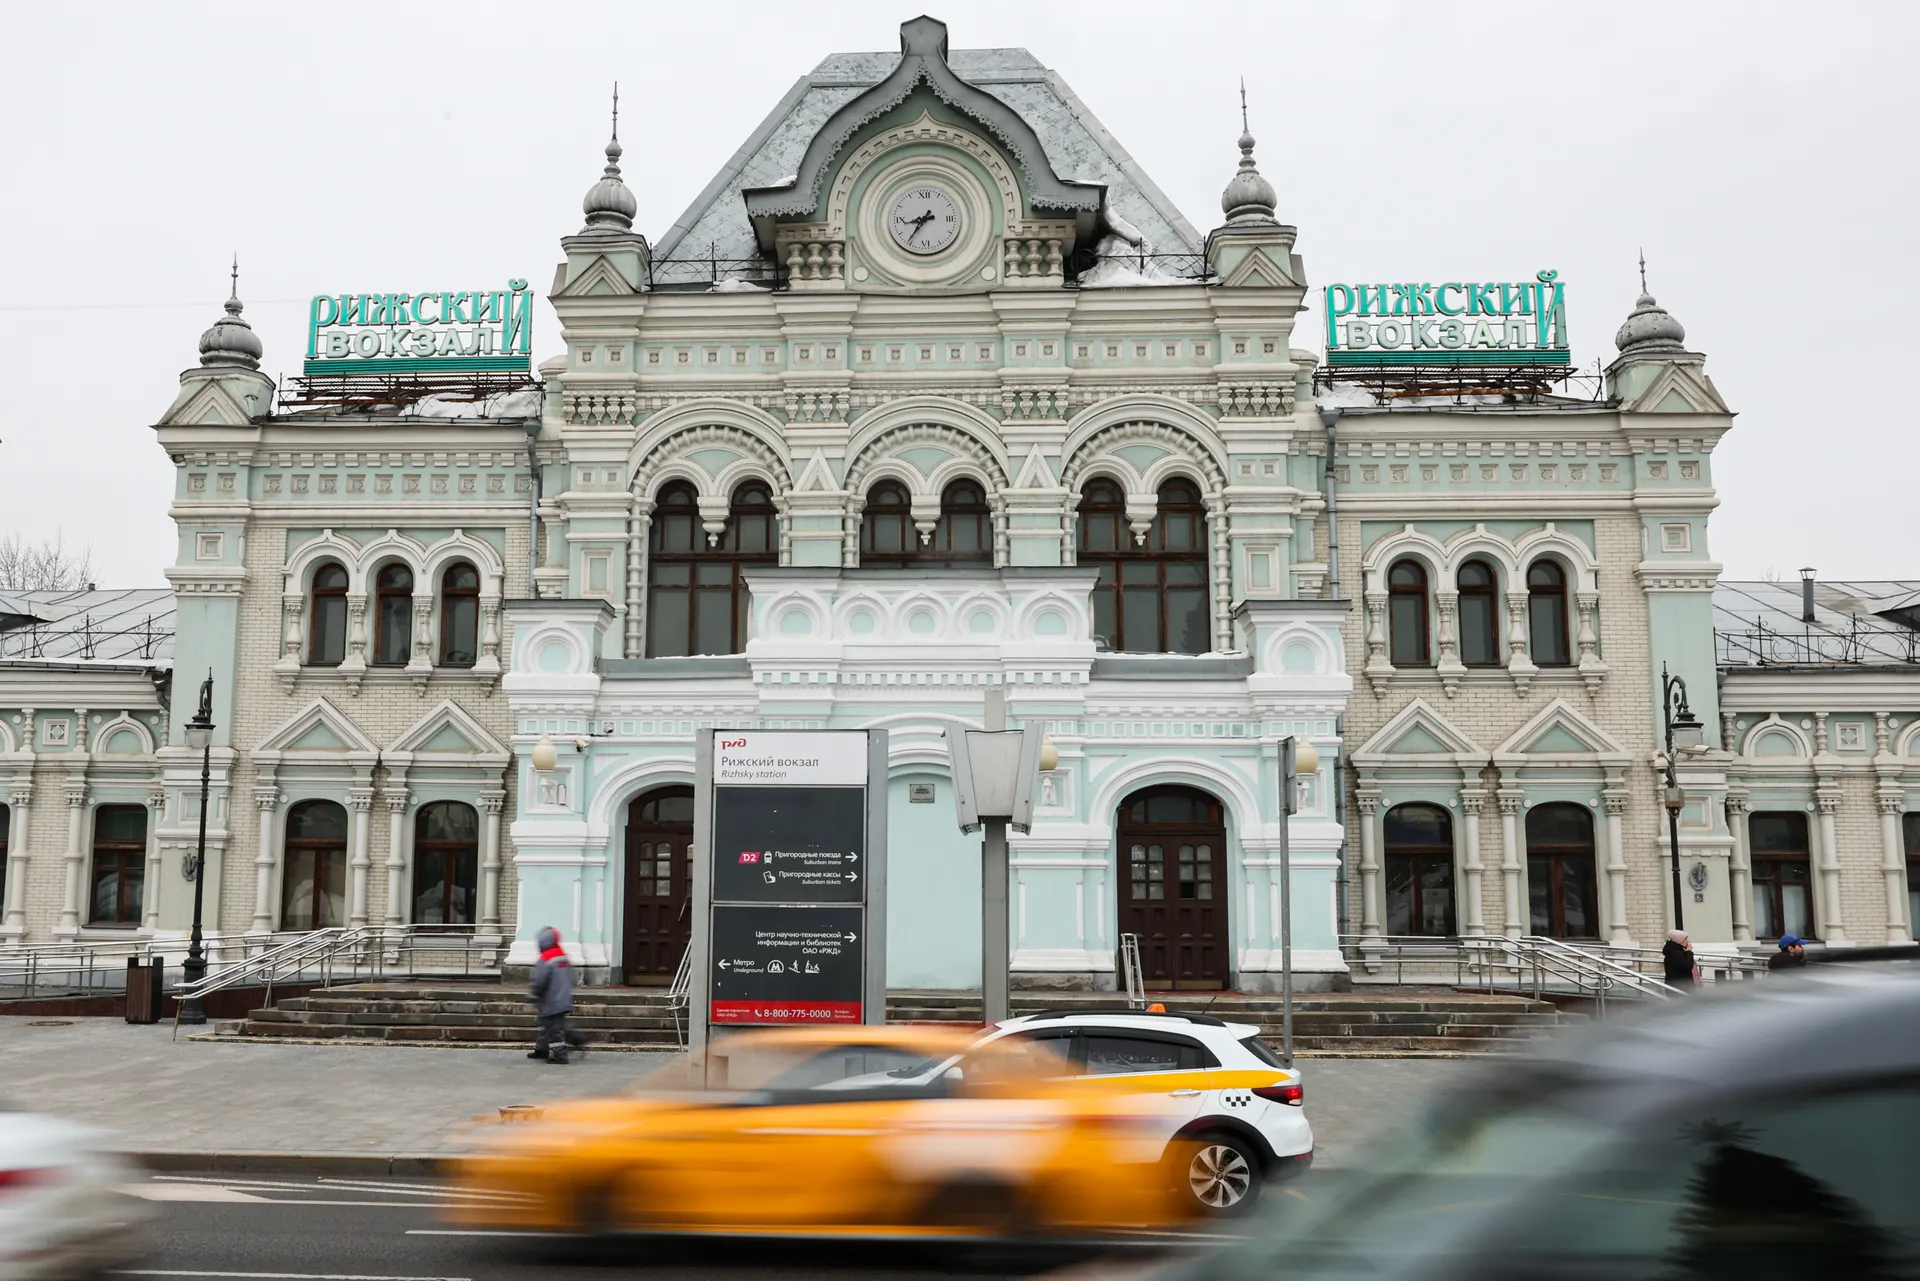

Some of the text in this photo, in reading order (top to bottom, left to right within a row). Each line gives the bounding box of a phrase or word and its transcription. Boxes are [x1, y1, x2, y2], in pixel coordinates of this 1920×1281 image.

[305, 278, 534, 359] РИЖСКИЙ
[1325, 269, 1569, 349] РИЖСКИЙ
[326, 328, 494, 358] ВОКЗАЛ
[1346, 319, 1527, 349] ВОКЗАЛ
[721, 756, 819, 767] Рижский вокзал
[721, 770, 787, 779] Rizhsky station
[775, 851, 818, 859] Пригородные
[764, 1009, 831, 1018] 8-800-775-0000
